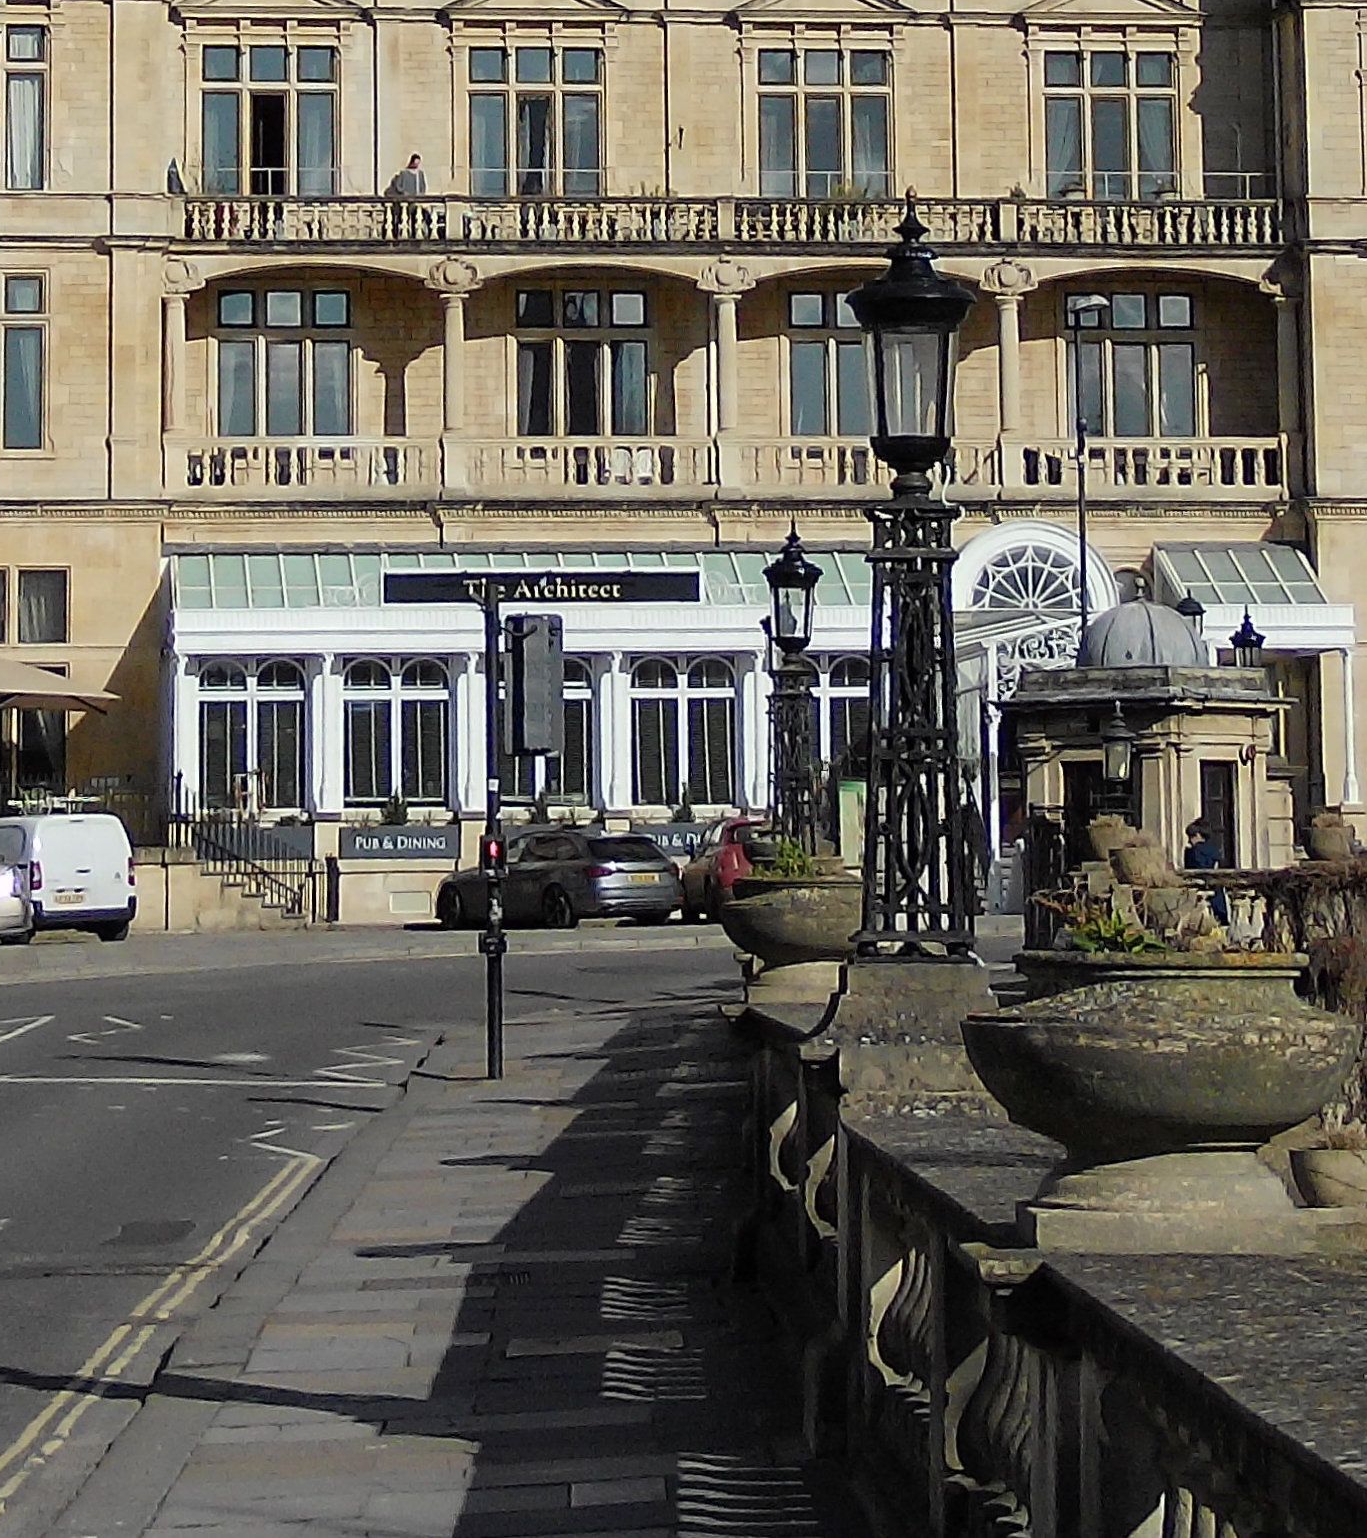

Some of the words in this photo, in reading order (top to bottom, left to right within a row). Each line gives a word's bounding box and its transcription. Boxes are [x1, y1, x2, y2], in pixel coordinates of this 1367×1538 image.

[514, 577, 621, 598] Architect
[355, 836, 380, 849] PUB
[382, 835, 393, 849] &
[397, 835, 446, 849] DINING
